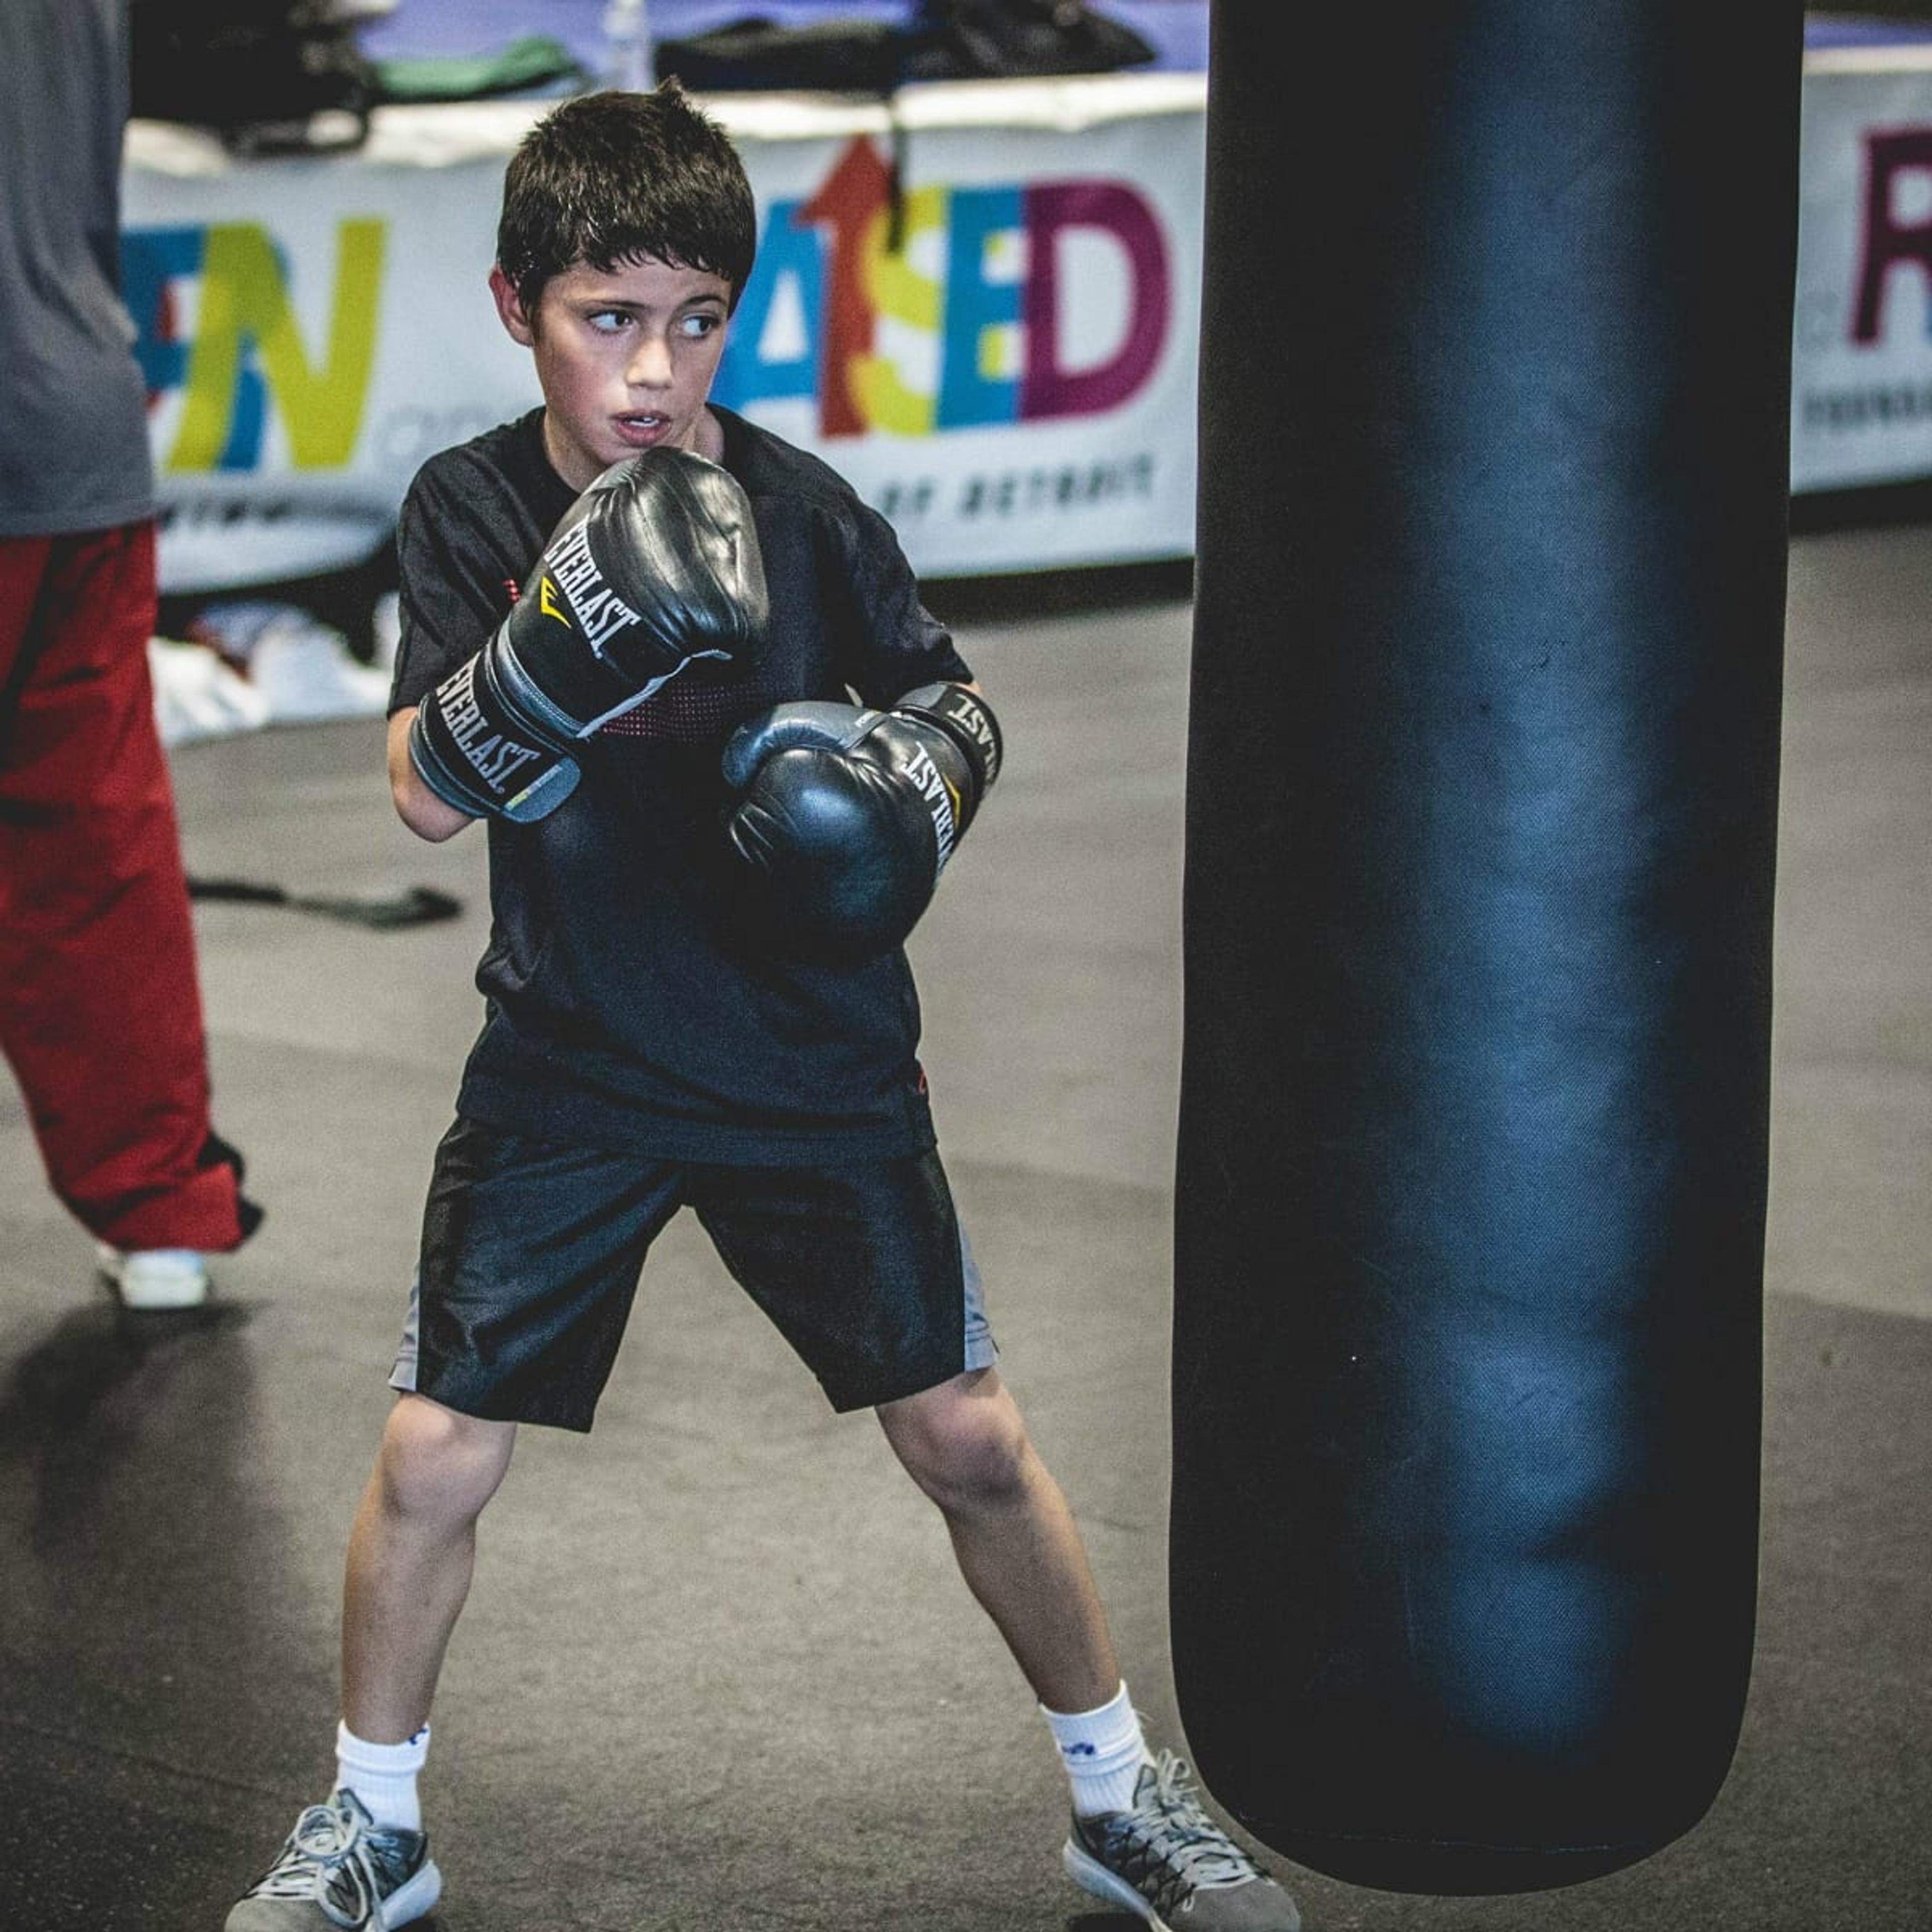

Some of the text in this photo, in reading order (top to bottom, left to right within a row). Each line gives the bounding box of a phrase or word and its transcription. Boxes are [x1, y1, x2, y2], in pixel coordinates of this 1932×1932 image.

[707, 132, 1172, 440] AISED
[543, 514, 641, 654] EVERLAST
[436, 652, 542, 792] EVERLAST
